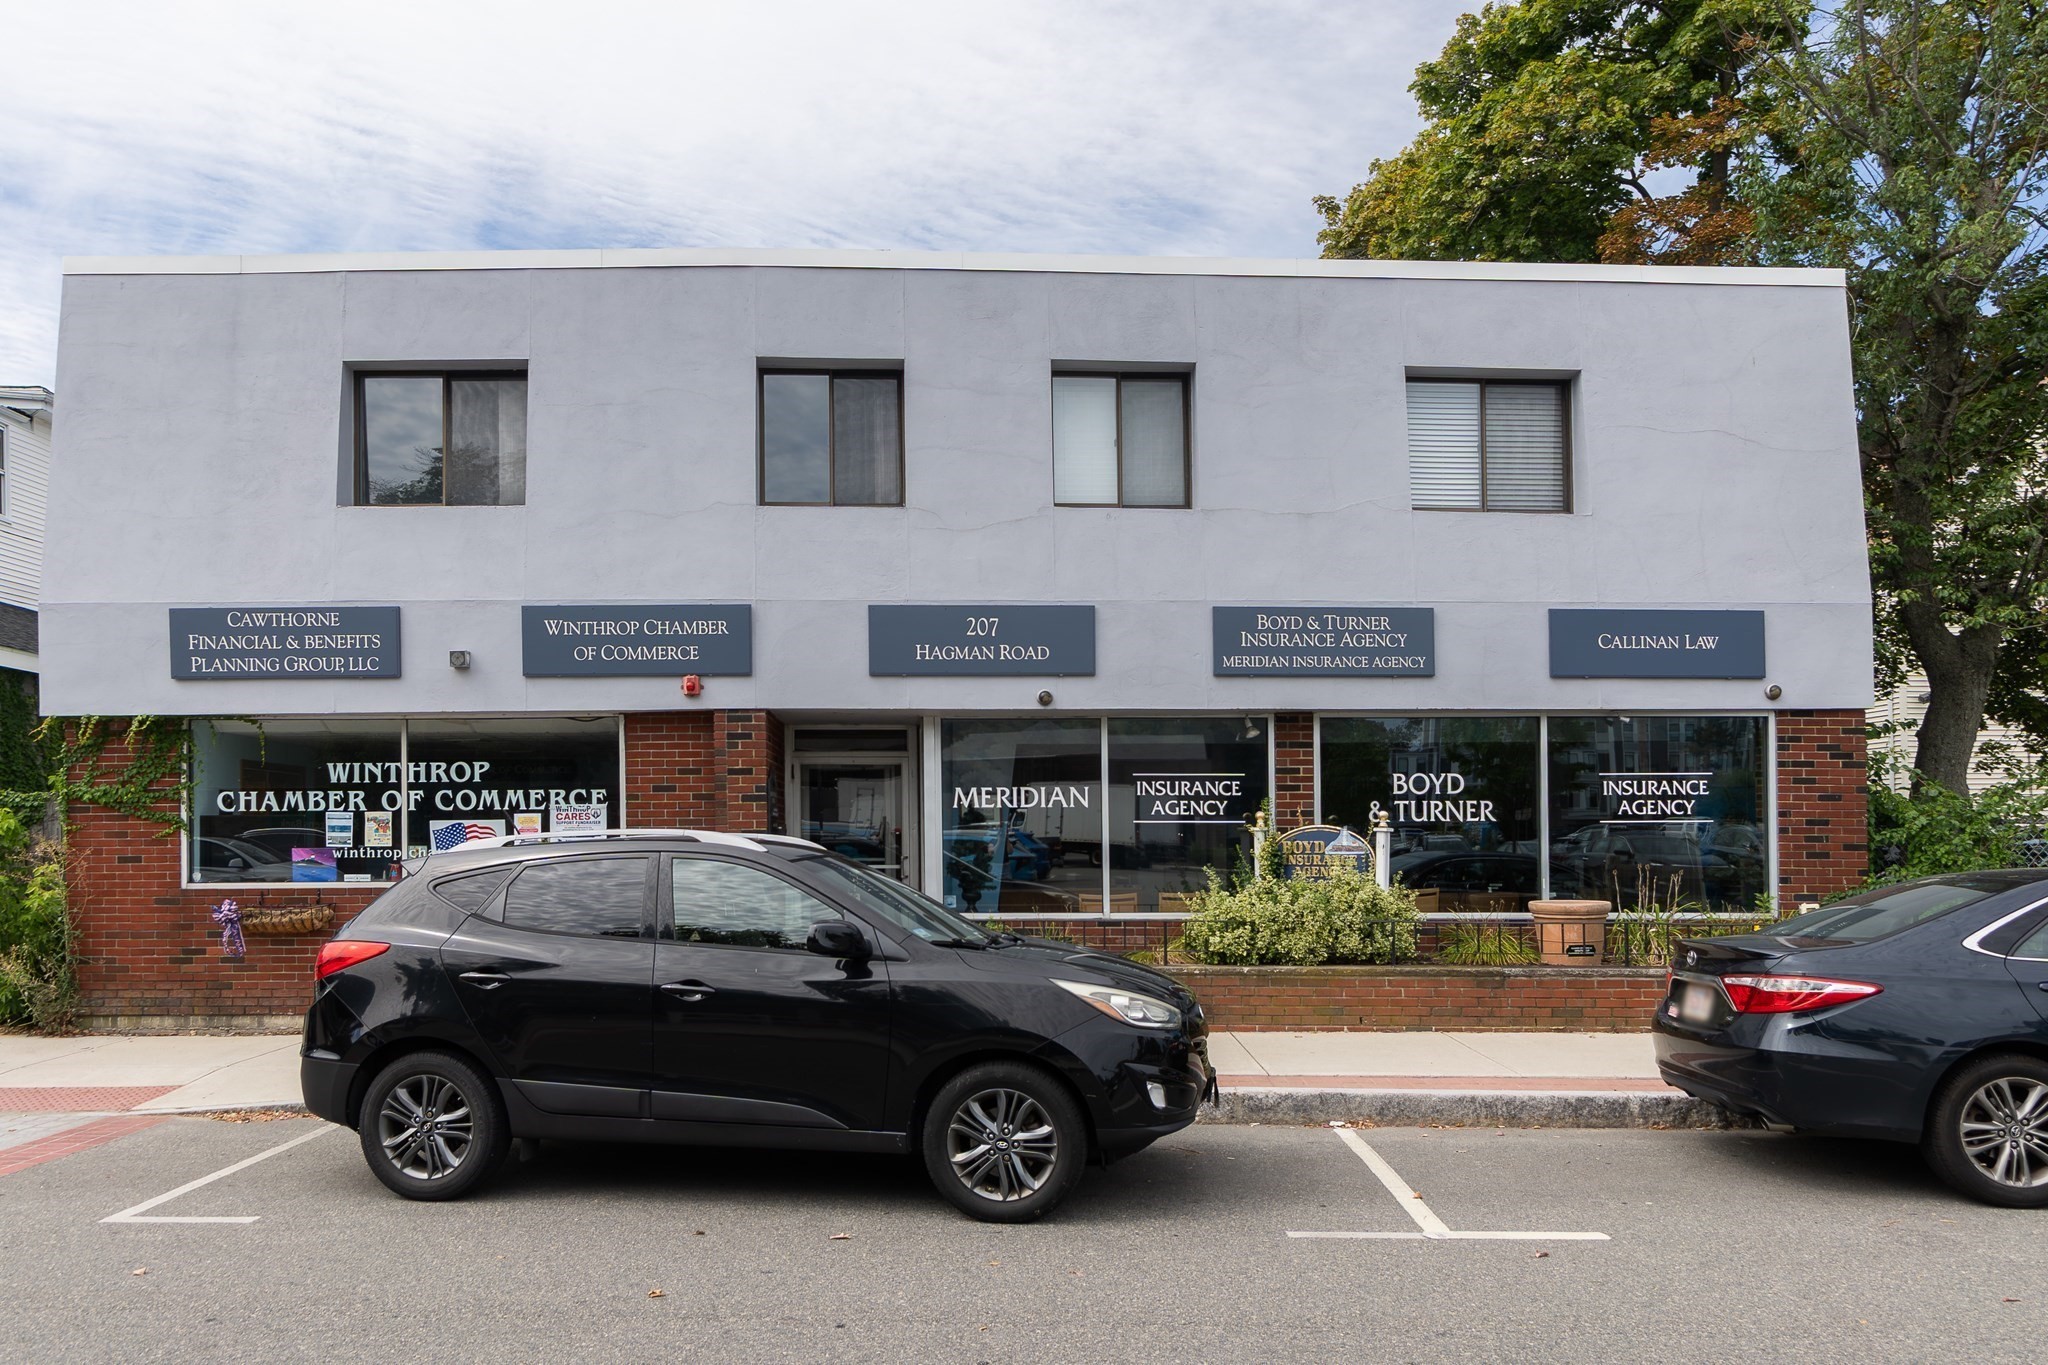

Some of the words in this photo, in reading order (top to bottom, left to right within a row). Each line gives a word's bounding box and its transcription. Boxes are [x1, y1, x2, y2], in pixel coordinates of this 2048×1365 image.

[227, 611, 340, 628] CAWTHORNE
[543, 619, 640, 635] WINTHROP
[643, 619, 729, 636] CHAMBER
[966, 617, 999, 637] 207
[1256, 614, 1303, 630] BOYD
[1306, 615, 1321, 630] &
[1323, 614, 1392, 631] TURNER
[188, 634, 283, 650] FINANCIAL
[285, 635, 301, 650] &
[304, 634, 381, 650] BENEFITS
[1240, 631, 1336, 648] INSURANCE
[1339, 631, 1408, 648] AGENCY
[1597, 633, 1680, 650] CALLINAN
[1684, 634, 1719, 650] LAW
[573, 646, 597, 661] OF
[600, 644, 700, 661] COMMERCE
[915, 644, 995, 661] HAGMAN
[999, 644, 1050, 661] ROAD
[190, 656, 280, 673] PLANNING
[283, 655, 345, 673] GROUP,
[348, 656, 379, 672] LLC
[1222, 655, 1289, 668] MERIDIAN
[1292, 655, 1368, 668] INSURANCE
[1371, 656, 1426, 668] AGENCY
[326, 761, 490, 783] WINTHROP
[1136, 780, 1242, 796] INSURANCE
[1392, 772, 1465, 795] BOYD
[1602, 779, 1710, 796] INSURANCE
[216, 790, 367, 812] CHAMBER
[381, 790, 423, 812] OF
[434, 788, 609, 812] COMMERCE
[952, 786, 1089, 809] MERIDIAN
[556, 812, 591, 820] CARES
[1150, 800, 1228, 816] AGENCY
[1393, 800, 1497, 823] TURNER
[1617, 799, 1696, 816] AGENCY
[333, 847, 402, 861] winthrop
[1281, 840, 1326, 854] BOYD
